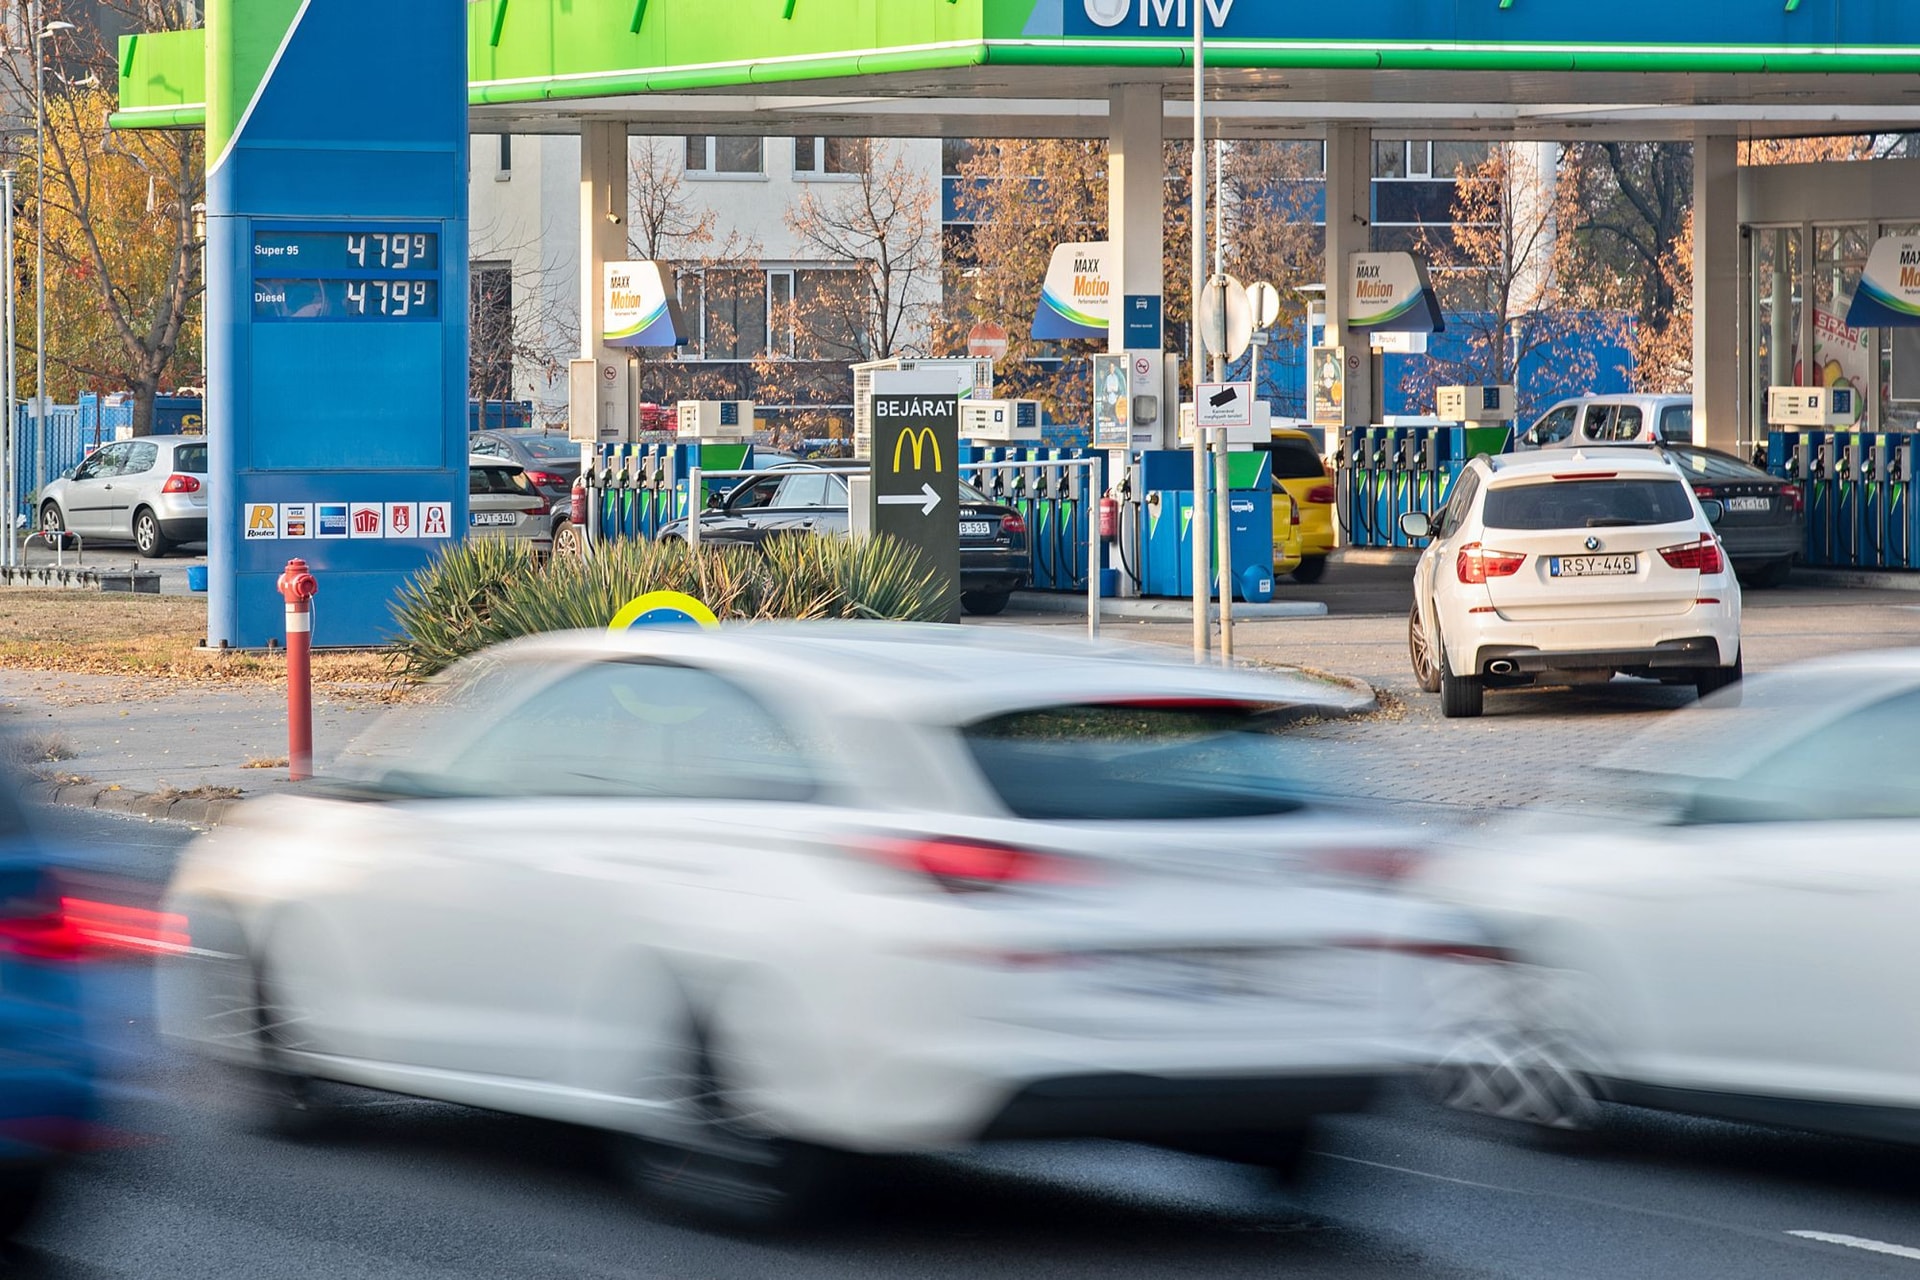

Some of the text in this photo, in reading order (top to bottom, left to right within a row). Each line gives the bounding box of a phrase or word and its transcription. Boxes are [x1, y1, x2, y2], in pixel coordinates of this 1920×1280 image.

[254, 245, 284, 257] Super
[286, 245, 299, 255] 95
[1073, 258, 1099, 273] MAXX
[1356, 265, 1380, 278] MAXX
[610, 275, 630, 289] MAXX
[1356, 280, 1393, 298] Motion
[254, 292, 286, 302] Diesel
[611, 290, 641, 309] Motion
[1818, 314, 1857, 340] SPAR
[876, 397, 956, 417] BEJÁRAT
[1810, 398, 1816, 407] 2
[477, 514, 514, 522] PVT-340
[247, 529, 275, 538] Routex
[1562, 556, 1632, 572] RSY-446
